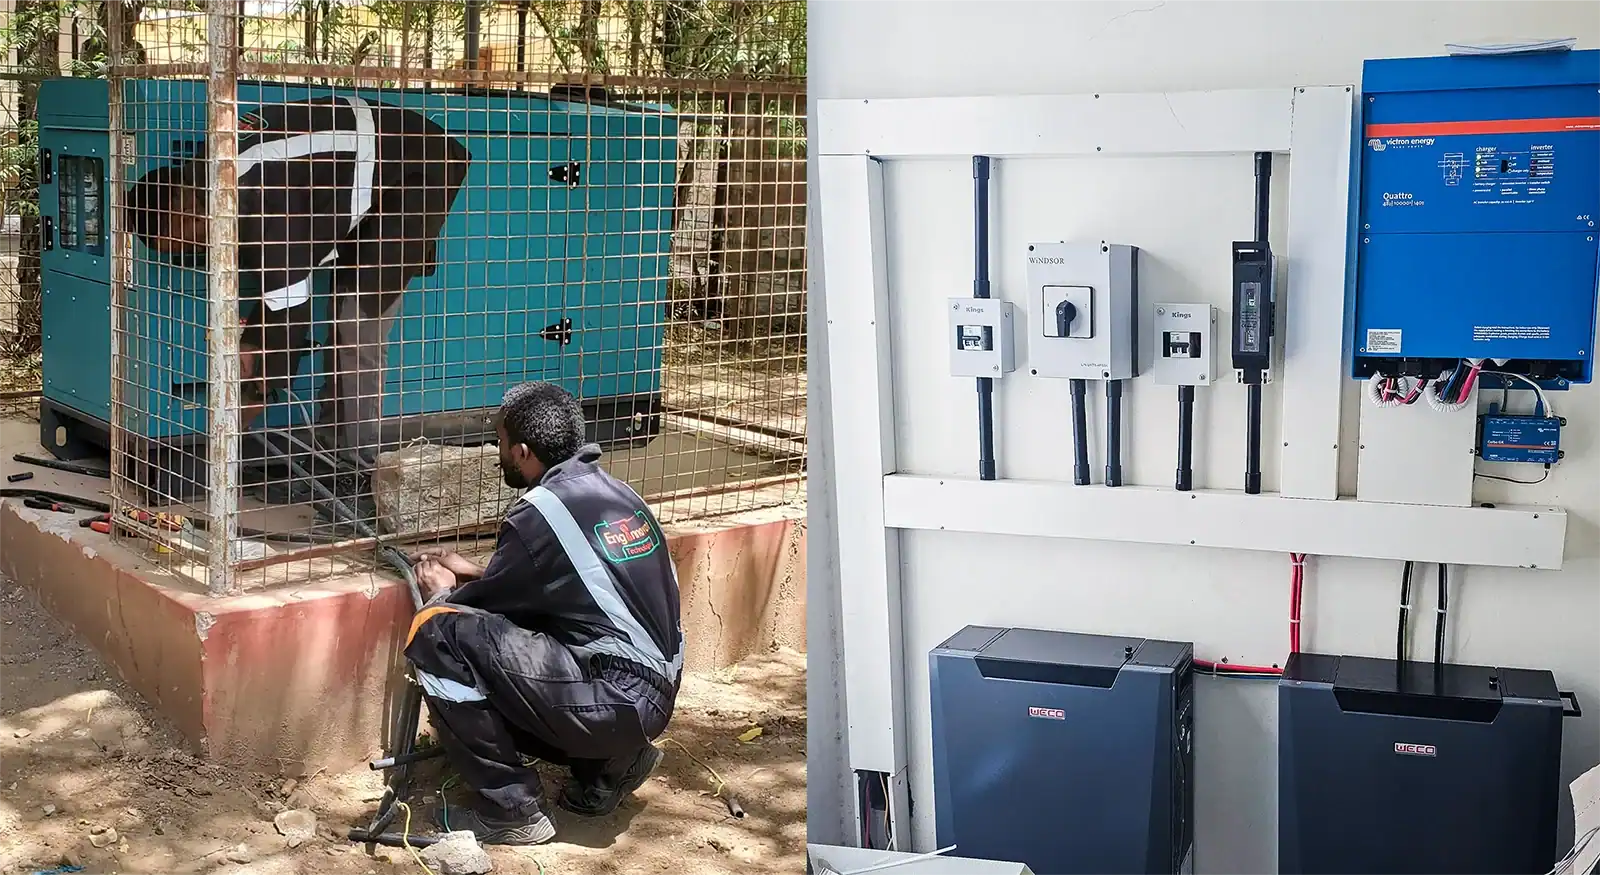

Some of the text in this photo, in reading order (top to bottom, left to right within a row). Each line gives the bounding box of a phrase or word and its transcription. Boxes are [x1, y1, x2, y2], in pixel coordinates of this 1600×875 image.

[1411, 138, 1435, 146] energy
[1383, 192, 1413, 201] Quattro
[965, 306, 985, 314] Kings
[1171, 311, 1192, 320] Kings
[1030, 708, 1065, 718] WECO
[1395, 744, 1435, 755] WECO
